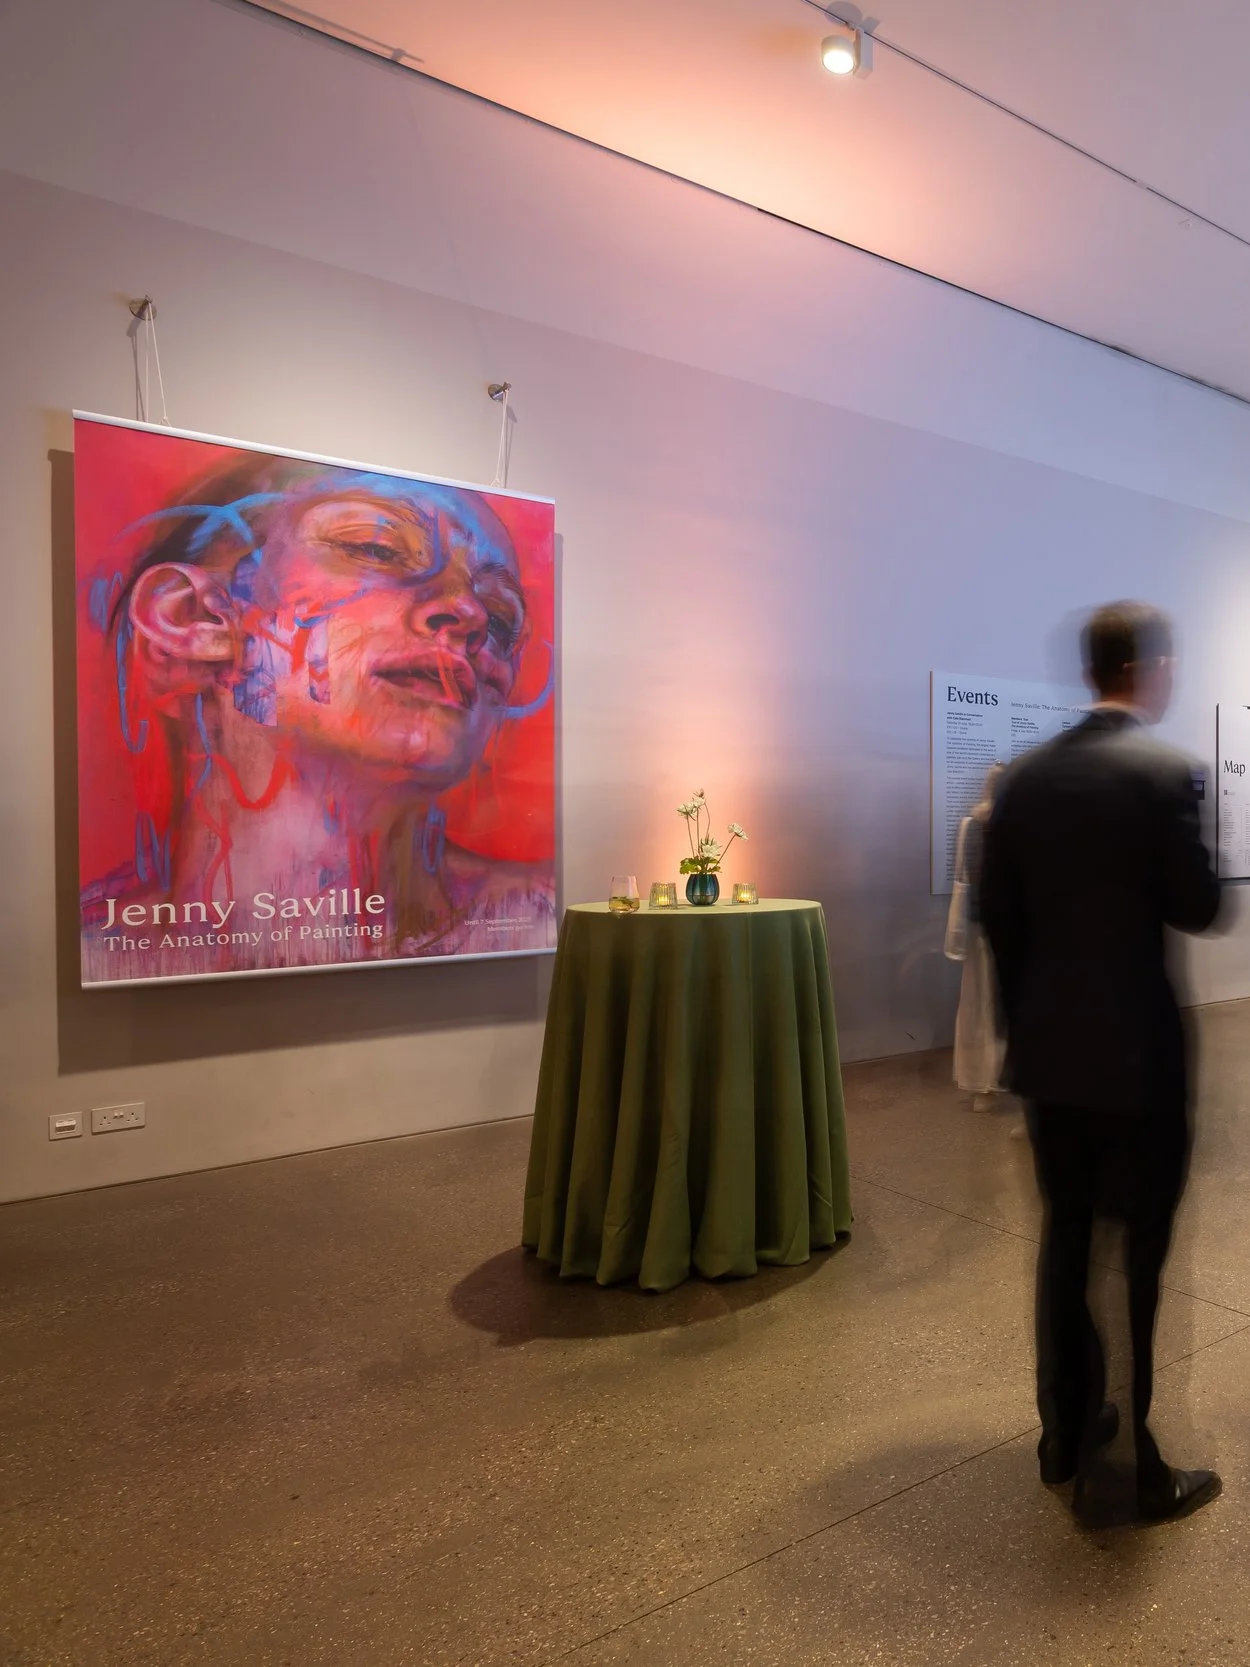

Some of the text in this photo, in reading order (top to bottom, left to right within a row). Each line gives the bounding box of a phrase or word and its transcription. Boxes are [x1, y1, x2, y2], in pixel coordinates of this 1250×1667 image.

[947, 686, 998, 706] Events
[1223, 760, 1246, 777] Map
[101, 888, 386, 929] Jenny Saville
[103, 923, 385, 951] The Anatomy of Painting
